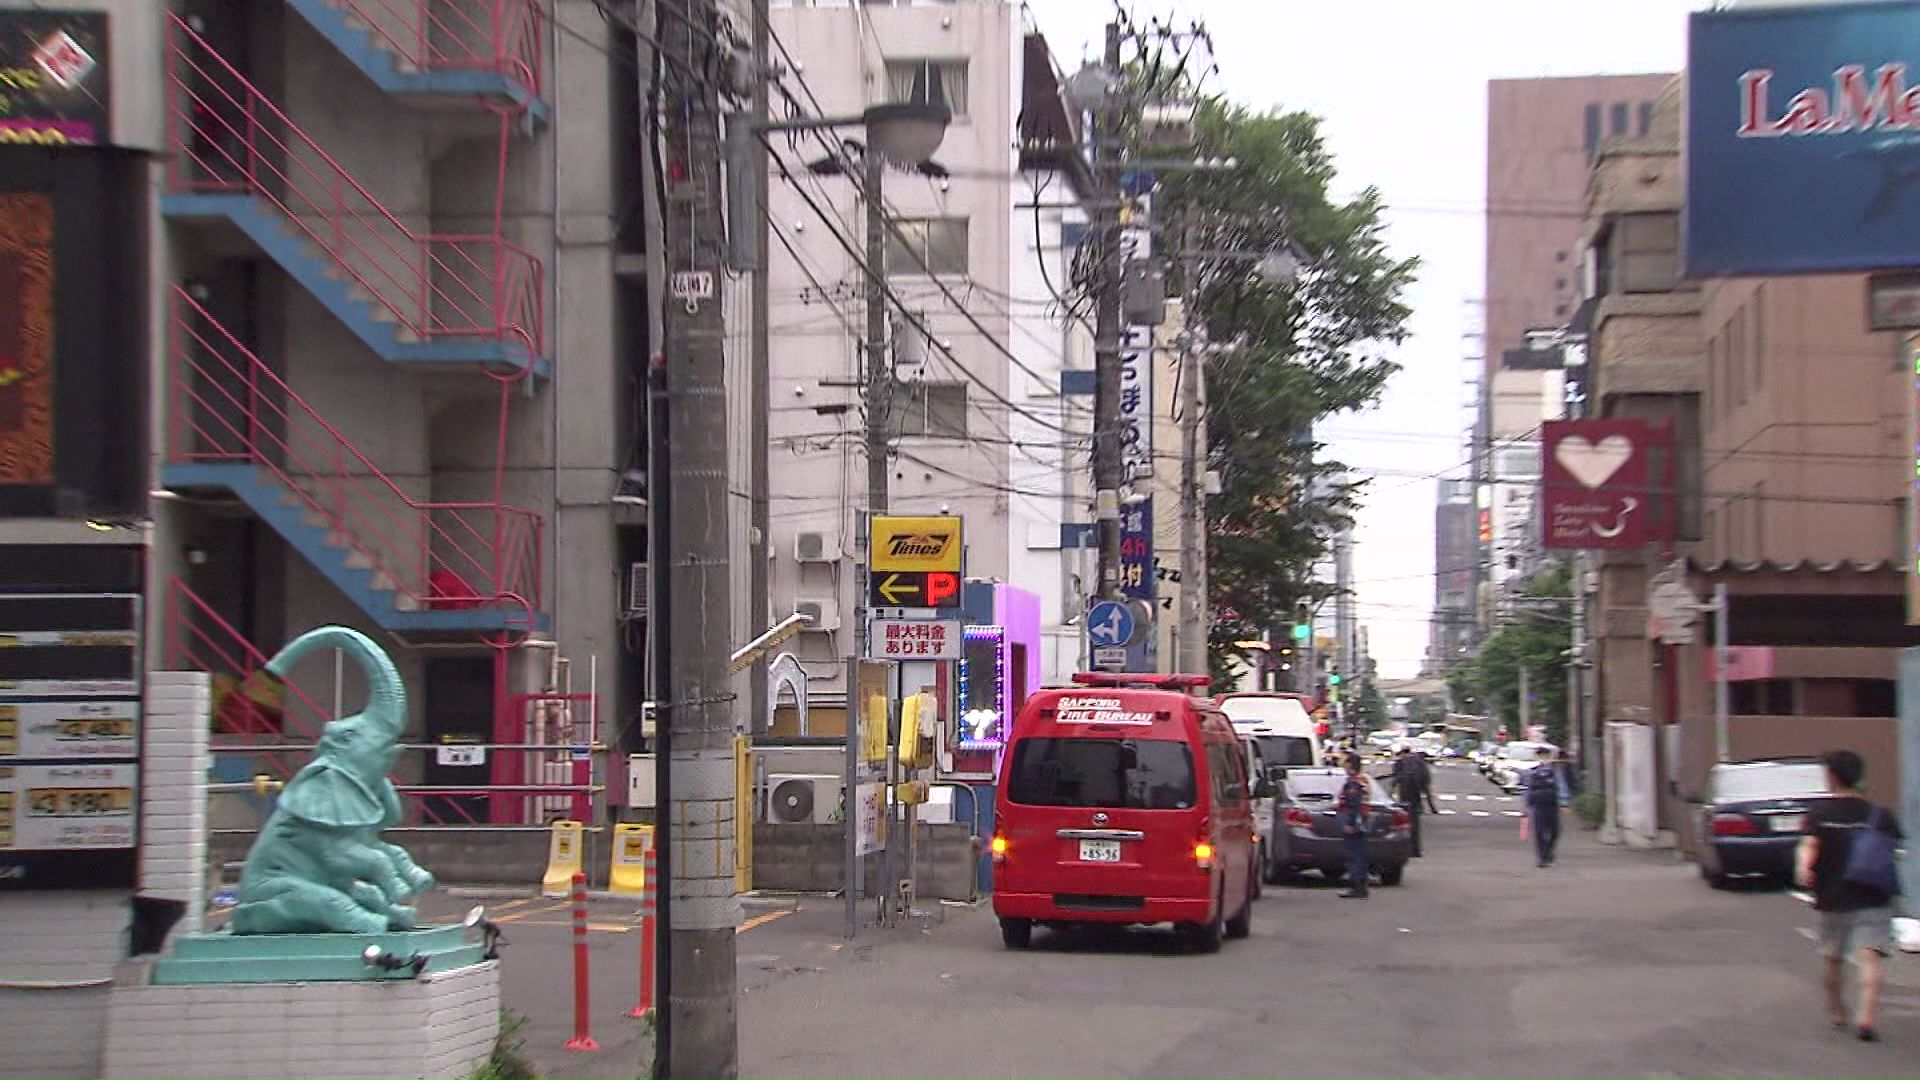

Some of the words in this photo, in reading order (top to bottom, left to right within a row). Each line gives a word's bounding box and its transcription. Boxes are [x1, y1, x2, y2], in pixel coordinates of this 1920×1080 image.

[888, 534, 949, 556] Times
[926, 573, 957, 606] P
[886, 624, 945, 640] 最大料金
[886, 641, 945, 656] あります
[1058, 697, 1121, 707] SAPPORO
[1057, 711, 1093, 721] FIRE
[1094, 711, 1153, 722] BUREAU
